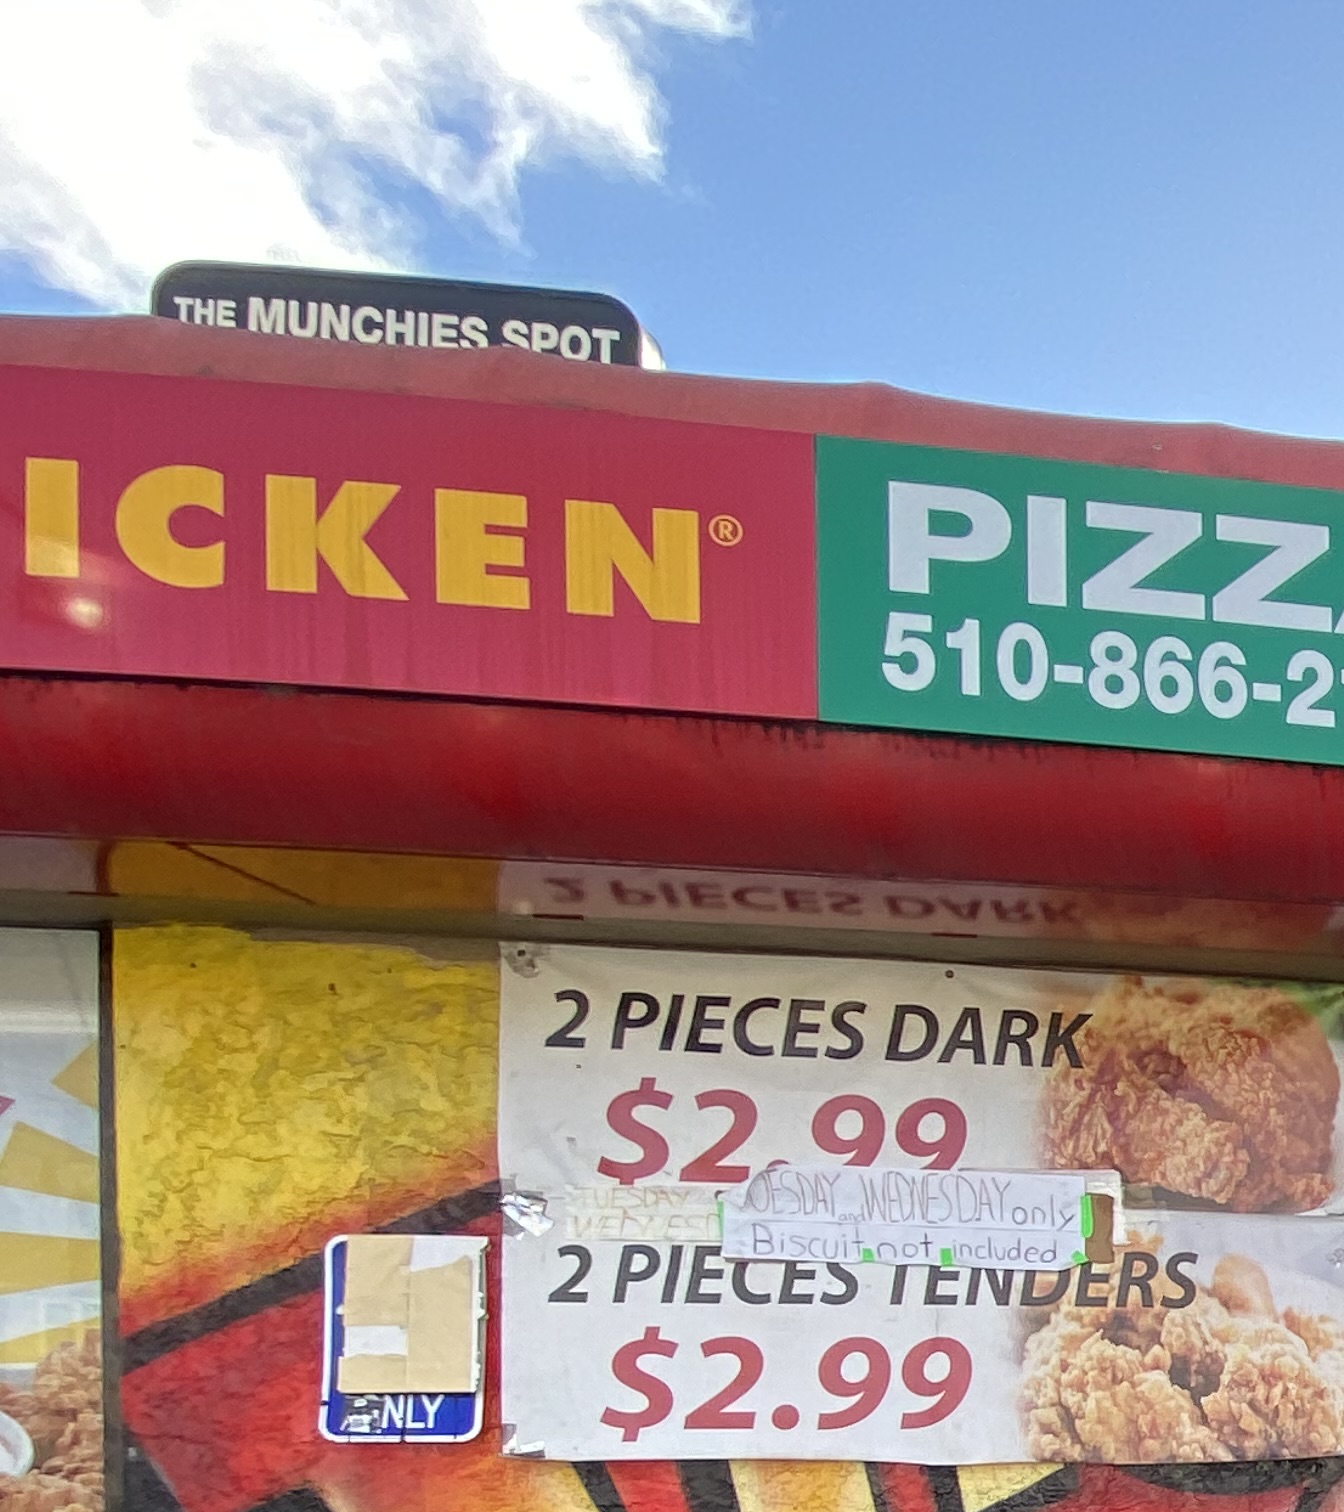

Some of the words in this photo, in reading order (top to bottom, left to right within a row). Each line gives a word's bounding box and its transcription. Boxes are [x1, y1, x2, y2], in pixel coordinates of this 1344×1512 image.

[173, 296, 237, 329] THE
[248, 297, 490, 351] MUNCHIES
[502, 319, 622, 365] SPOT
[545, 989, 590, 1050] 2
[611, 990, 867, 1061] PIECES
[885, 1006, 1095, 1070] DARK
[838, 1203, 866, 1223] and
[859, 1170, 1012, 1226] WEDNESDAY
[1010, 1193, 1077, 1233] only
[546, 1244, 593, 1304] 2
[612, 1244, 860, 1308] PIECES
[750, 1221, 866, 1262] Biscuit
[876, 1232, 934, 1260] not
[951, 1235, 1058, 1265] included
[600, 1324, 975, 1443] $2.99
